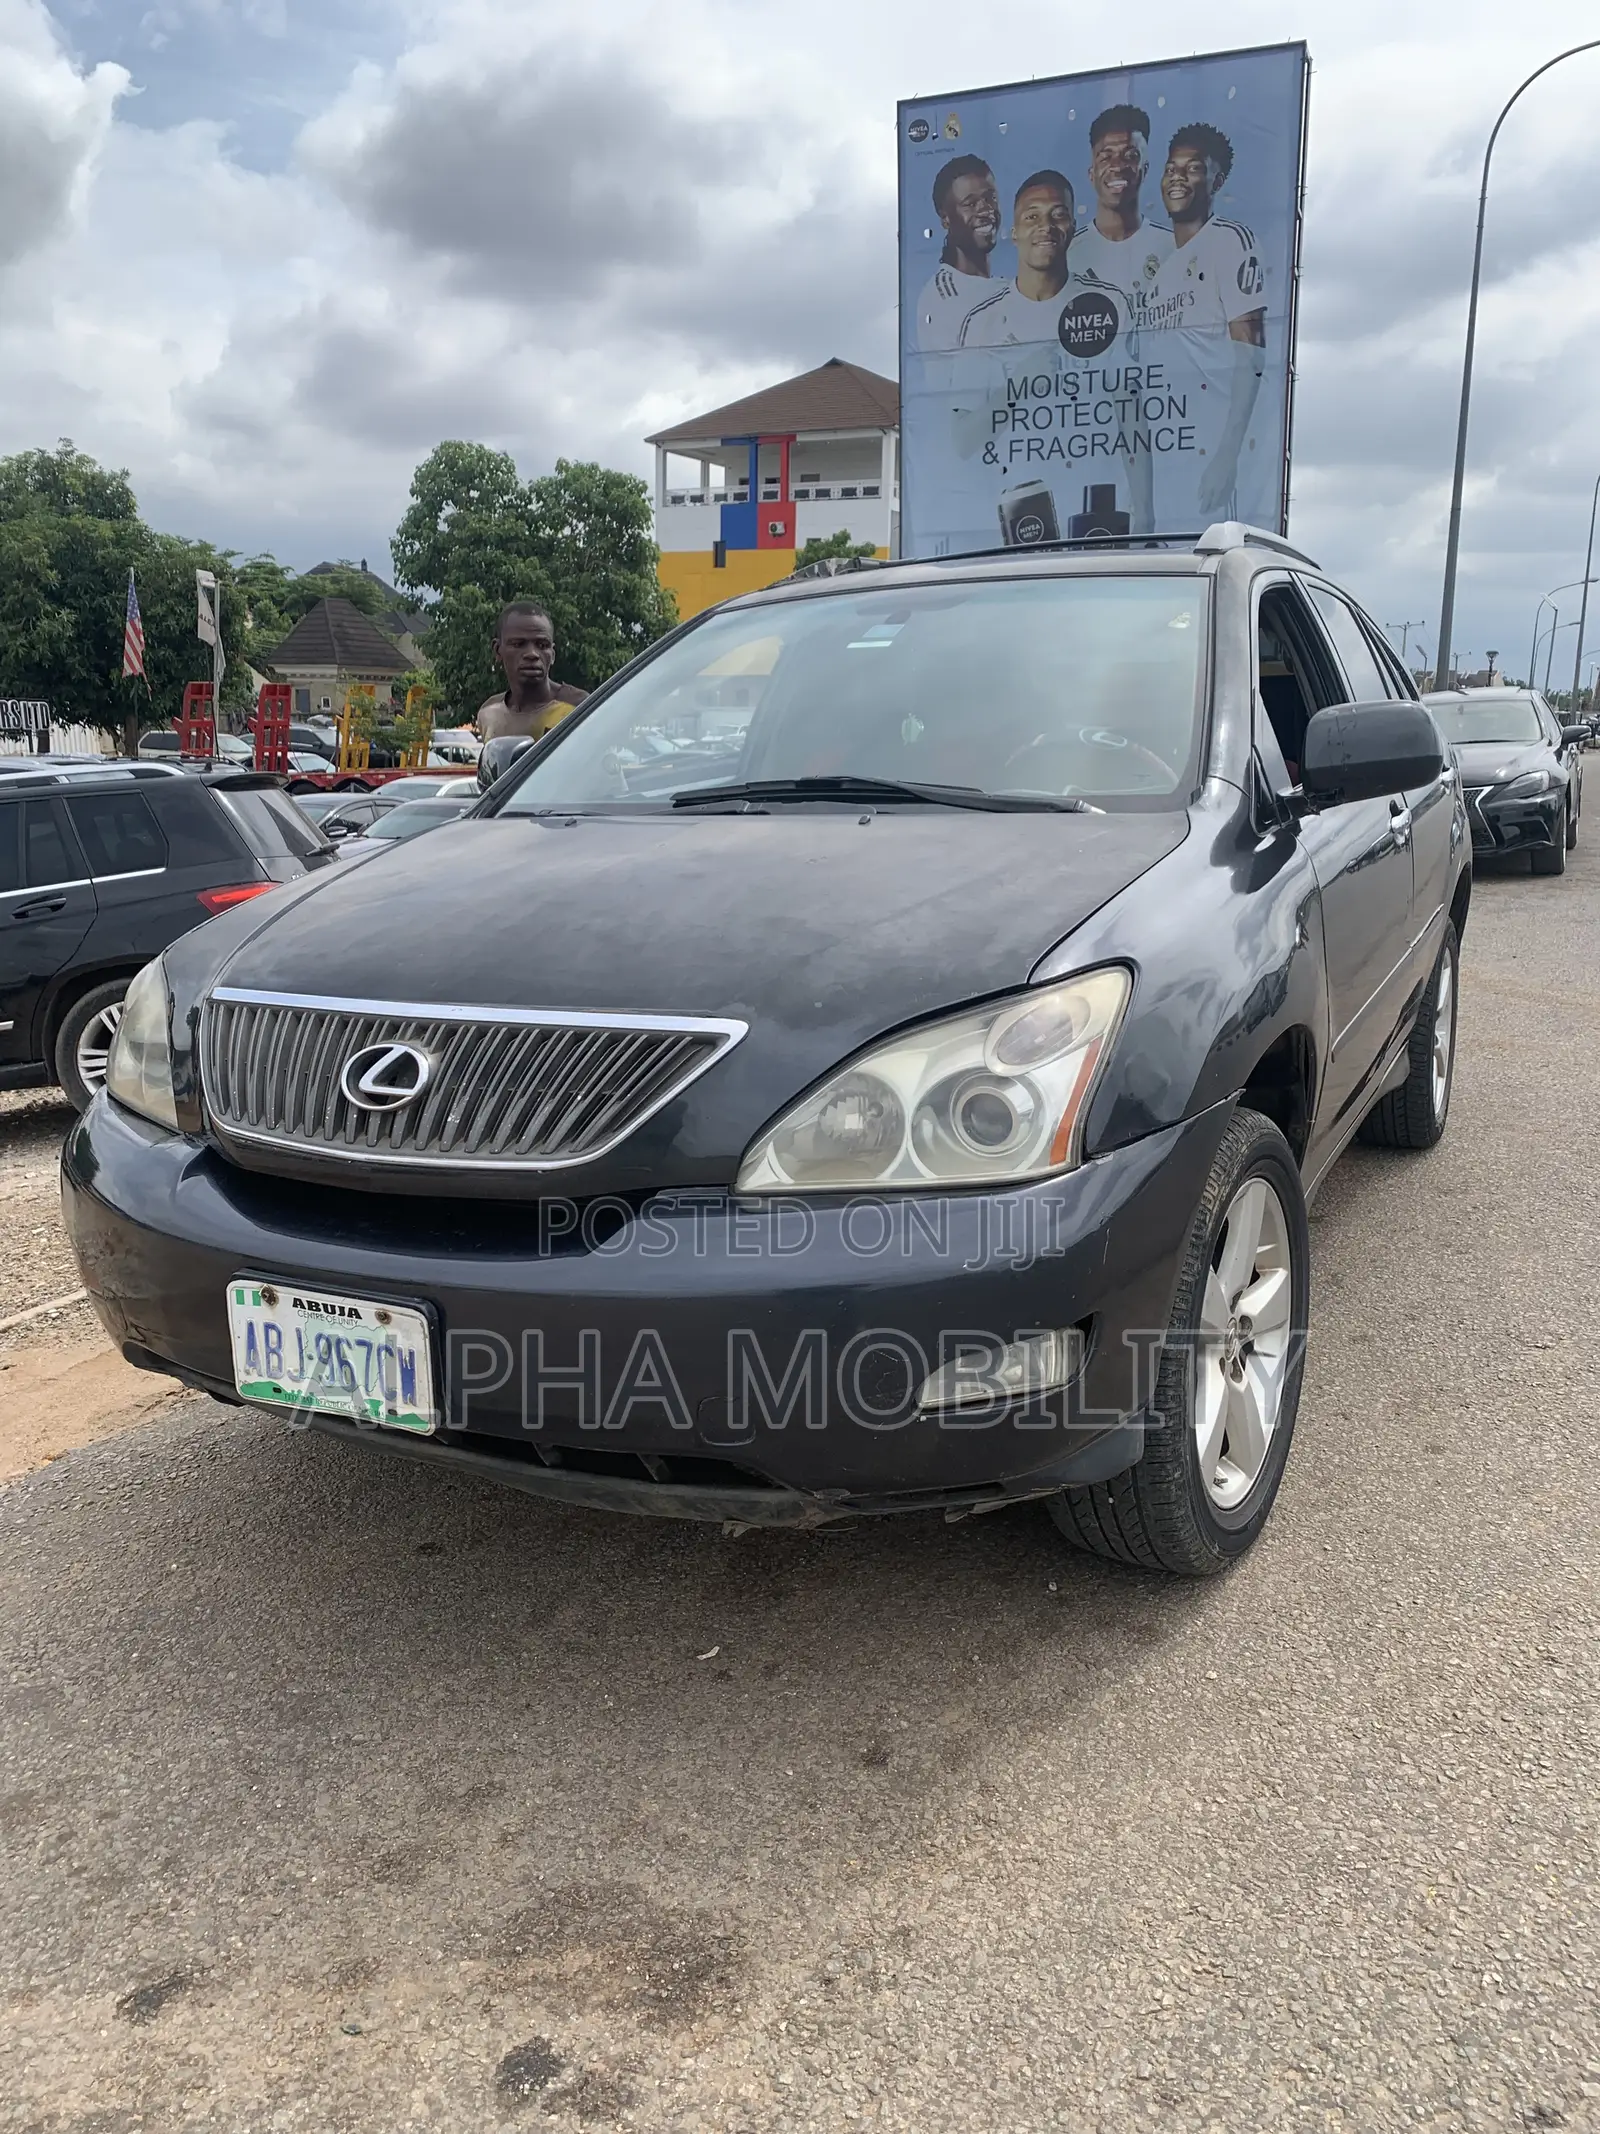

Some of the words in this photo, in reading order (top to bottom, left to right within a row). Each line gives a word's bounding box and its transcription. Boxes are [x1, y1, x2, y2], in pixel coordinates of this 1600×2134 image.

[1064, 313, 1113, 330] NIVEA
[1070, 329, 1106, 343] MEN
[1006, 364, 1172, 402] MOISTURE,
[992, 394, 1187, 433] PROTECTION
[982, 441, 1000, 465] &
[1009, 426, 1196, 463] FRAGRANCE
[1019, 523, 1041, 534] NIVEA
[1023, 530, 1040, 539] MEN
[292, 1297, 363, 1320] ABUJA
[297, 1309, 325, 1322] CENTRE
